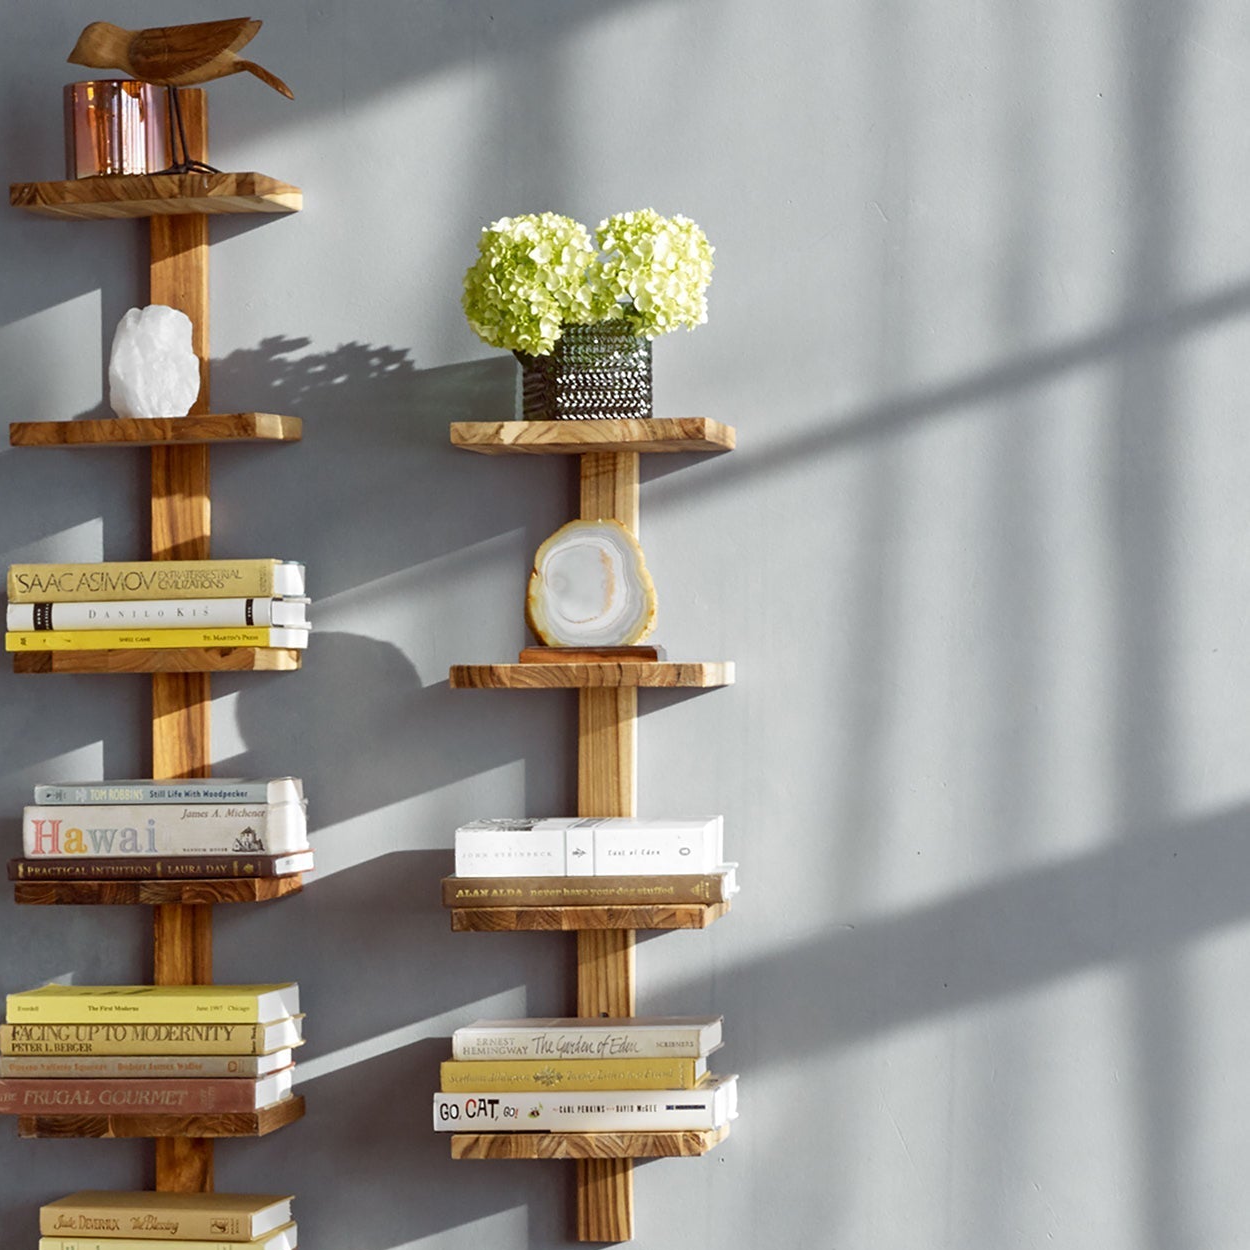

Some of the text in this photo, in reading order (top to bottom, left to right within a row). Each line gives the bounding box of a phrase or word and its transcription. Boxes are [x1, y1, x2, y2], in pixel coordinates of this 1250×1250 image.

[76, 570, 157, 592] ASIMOV
[158, 569, 243, 581] EXTRATERRESTRIAL
[158, 579, 225, 590] CIVILIZATIONS
[90, 788, 144, 801] TOM ROBBINS
[149, 789, 248, 800] Still Life With Woodpecker
[180, 807, 267, 820] James A. Michener
[27, 863, 228, 876] PRACTICAL INTUITION LAURA DAY
[456, 886, 675, 898] ALAN ALDA never have your dog stuffed
[11, 1025, 235, 1042] FACING UP TO MODERNITY
[11, 1043, 92, 1053] PETER L. BERGER
[476, 1037, 515, 1047] ERNEST
[531, 1033, 642, 1058] The Garden of Eden
[462, 1045, 529, 1056] HEMINGWAY
[23, 1090, 95, 1105] FRUGAL
[96, 1090, 189, 1105] GOURMET
[440, 1098, 519, 1121] GO, CAT, GO!
[559, 1105, 605, 1113] CARL PERKINS
[616, 1104, 634, 1113] DAVID
[143, 1214, 180, 1235] Blessing
